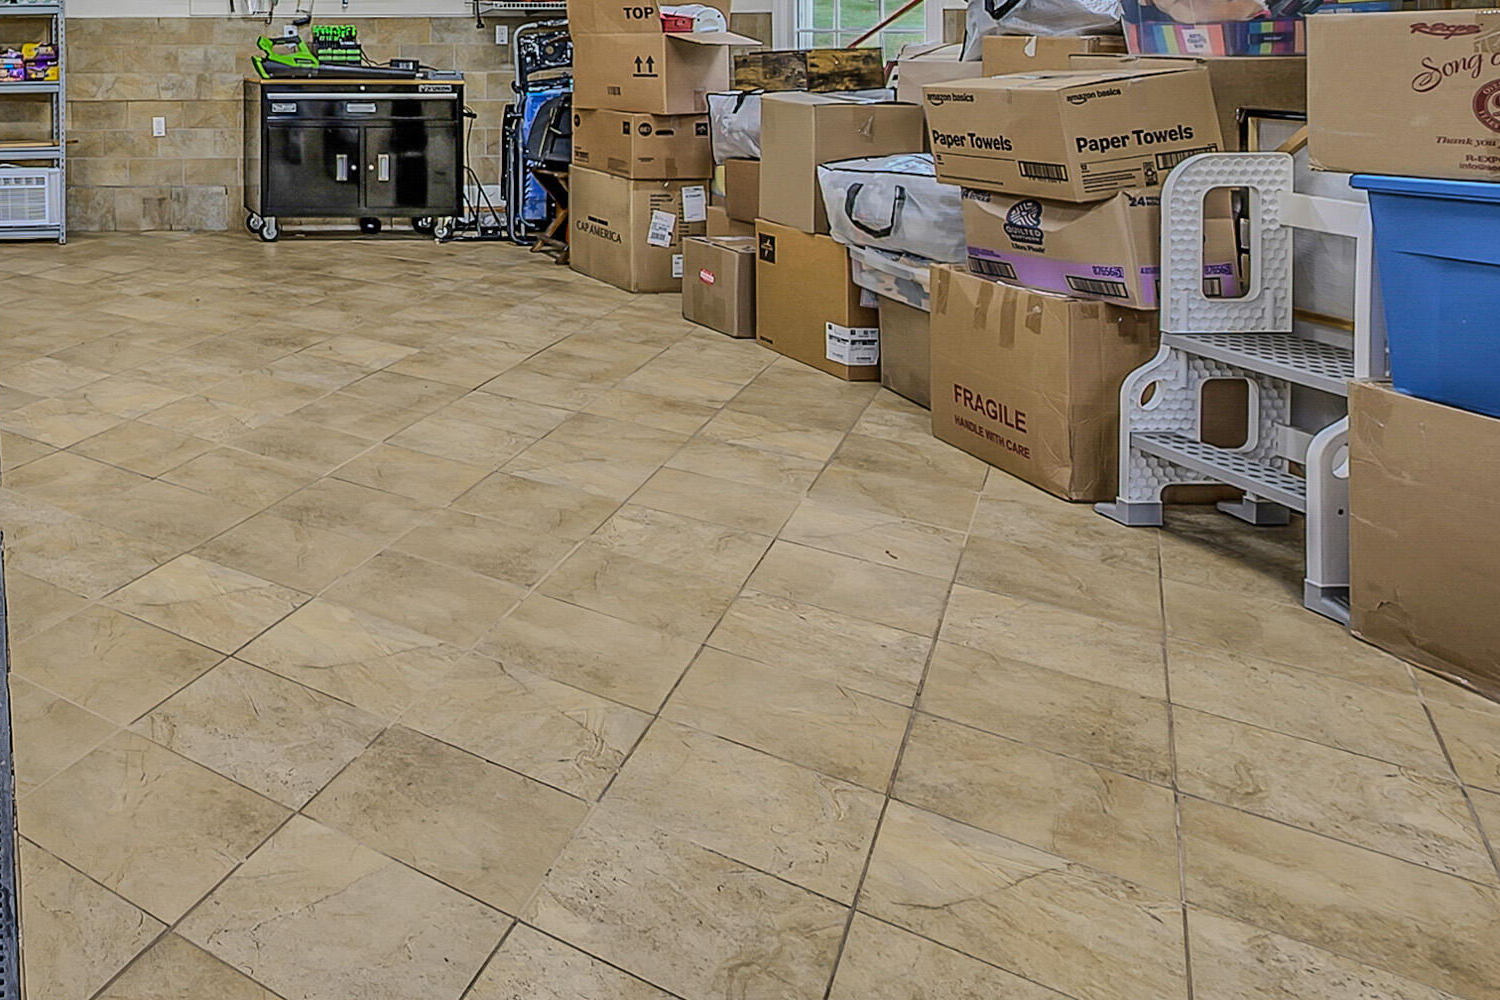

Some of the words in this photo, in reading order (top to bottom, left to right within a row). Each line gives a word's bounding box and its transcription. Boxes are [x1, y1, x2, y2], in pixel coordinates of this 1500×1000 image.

[623, 7, 655, 19] TOP
[1411, 52, 1483, 92] Song
[927, 94, 951, 105] amazon
[952, 93, 975, 102] basics
[1066, 92, 1097, 105] amazon
[1097, 88, 1121, 98] basics
[932, 129, 966, 149] Paper
[967, 132, 1013, 151] Towels
[1075, 134, 1130, 153] Paper
[1132, 125, 1194, 145] Towels
[1436, 136, 1473, 145] Thank
[1474, 139, 1496, 147] you
[1466, 155, 1500, 163] R-EXP
[1129, 196, 1146, 207] 24
[576, 220, 589, 233] CAP
[589, 226, 622, 244] AMERICA
[1005, 224, 1042, 237] QUILTED
[953, 383, 1028, 434] FRAGILE
[954, 414, 985, 437] HANDLE
[985, 430, 1006, 447] WITH
[1005, 438, 1031, 460] CARE
